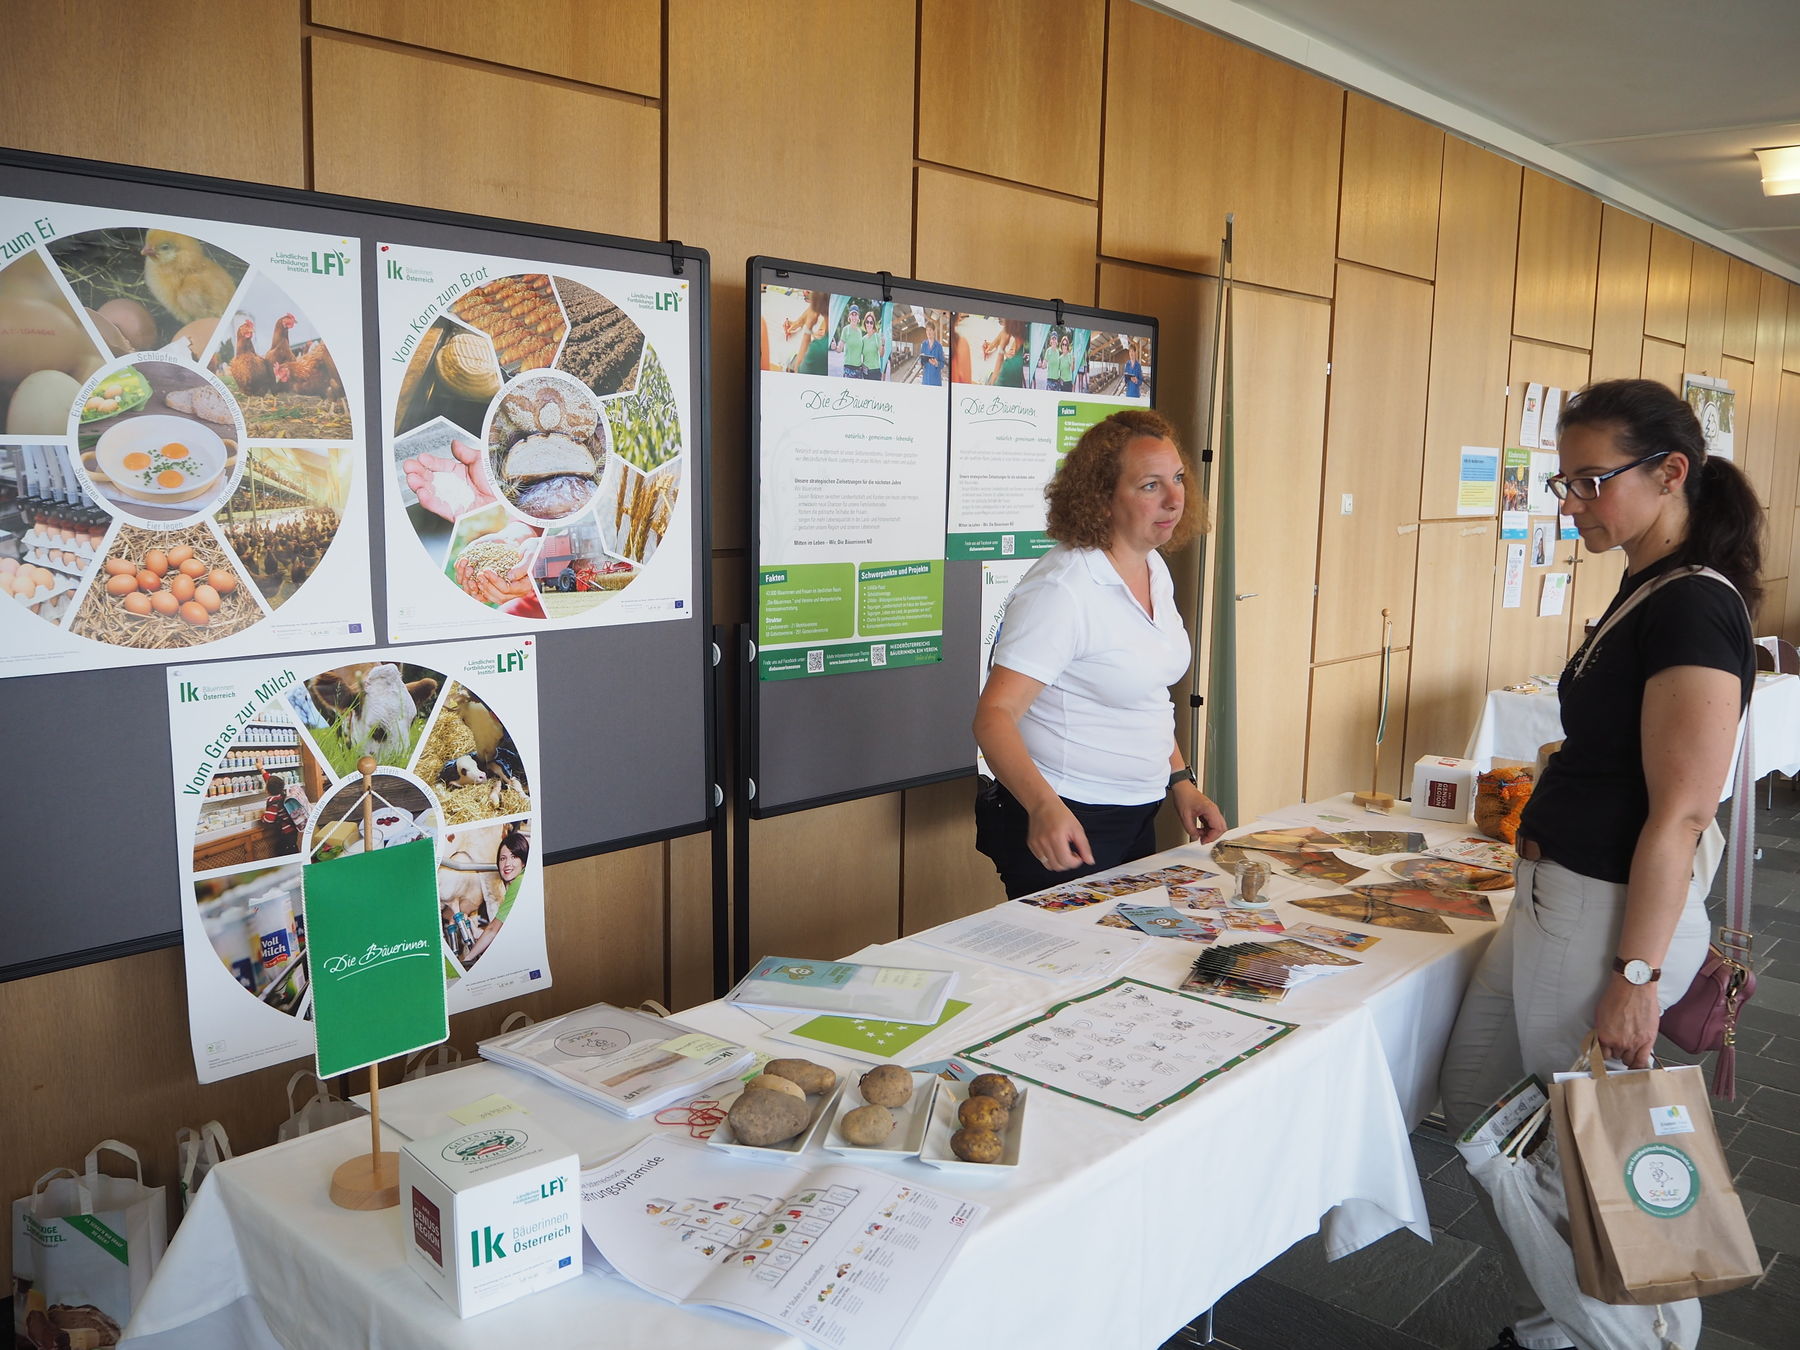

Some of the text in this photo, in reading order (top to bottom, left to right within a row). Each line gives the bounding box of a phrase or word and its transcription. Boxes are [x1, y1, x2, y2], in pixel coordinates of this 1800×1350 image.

[0, 217, 56, 259] zum Ei
[392, 266, 489, 364] Vom Korn zum Brot
[137, 352, 178, 363] Schlüpfen
[209, 375, 244, 431] Freilandhaltung
[801, 390, 830, 410] Die
[960, 397, 985, 414] Die
[75, 467, 99, 500] Sortieren
[218, 459, 245, 504] Bodenhaltung
[147, 521, 161, 530] Eier
[765, 573, 785, 583] Fakten
[861, 566, 929, 580] Schwerpunkte und Projekte
[984, 624, 997, 646] Vom
[203, 691, 237, 701] Österreich
[183, 668, 298, 798] Vom Gras zur Milch
[1435, 782, 1443, 807] REGION
[261, 936, 279, 948] Voll
[324, 955, 357, 974] Die
[449, 1135, 480, 1150] GUTES
[582, 1155, 665, 1203] ährungspyramide
[414, 1207, 440, 1237] GENUSS
[512, 1211, 568, 1239] Bäuerinnen
[414, 1220, 441, 1250] REGION
[513, 1224, 571, 1253] Österreich
